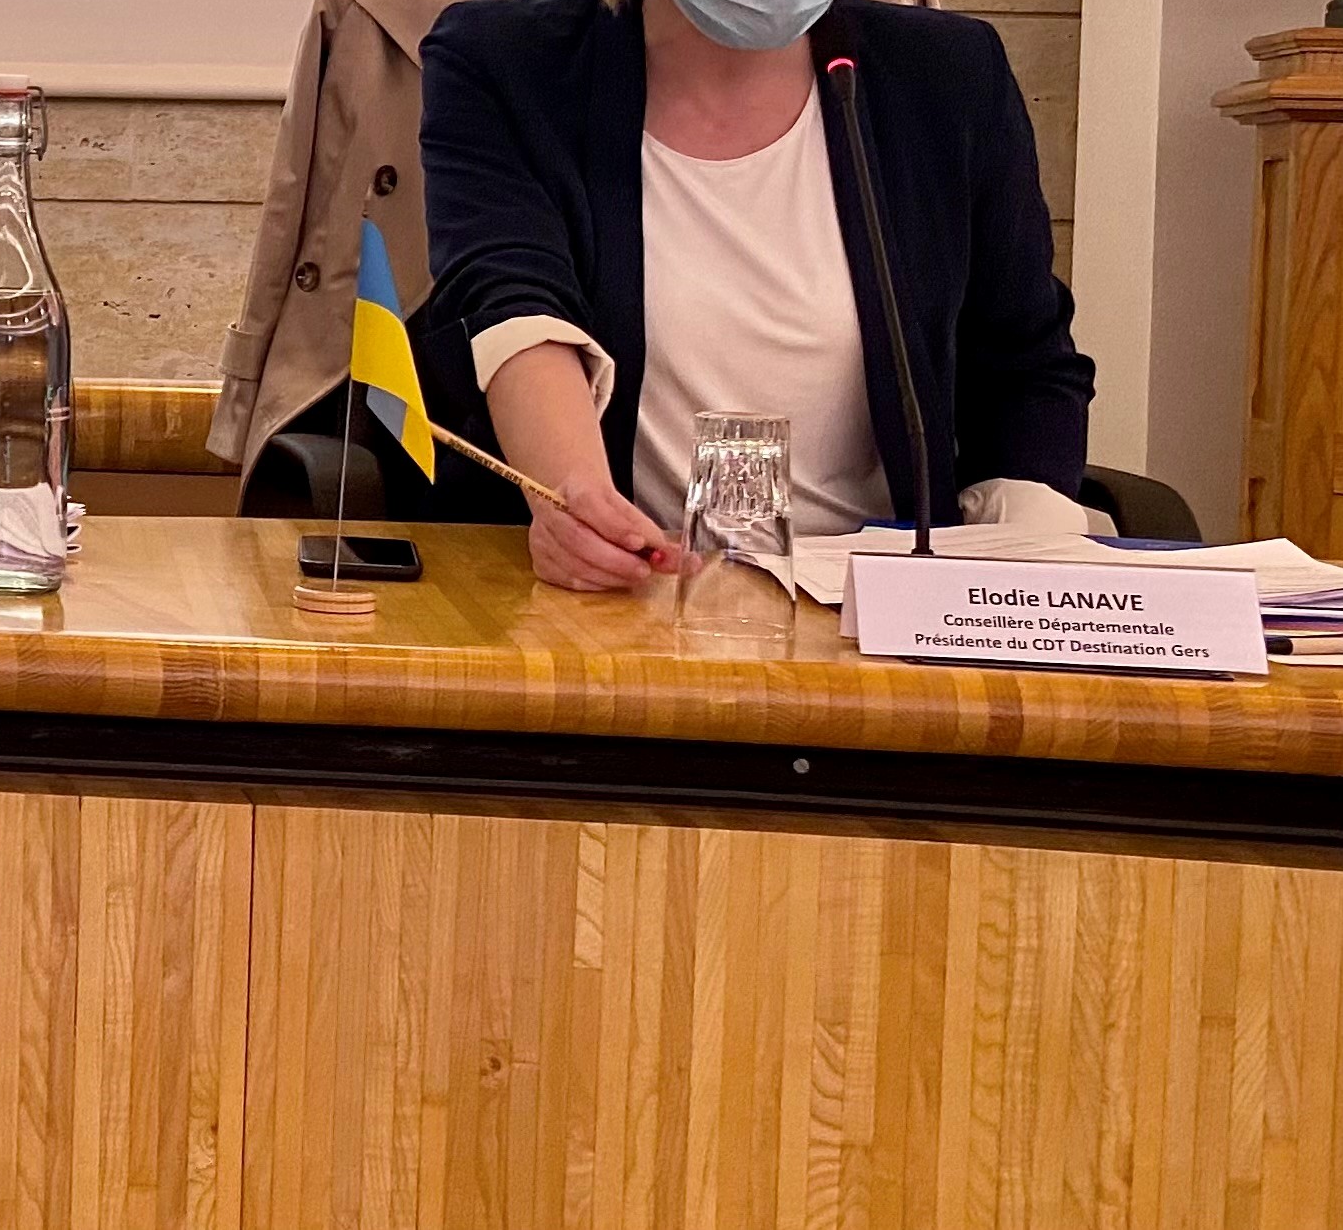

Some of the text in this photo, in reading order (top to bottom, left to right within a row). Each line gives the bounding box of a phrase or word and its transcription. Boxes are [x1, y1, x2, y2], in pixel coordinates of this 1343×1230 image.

[968, 588, 1146, 612] Elodie LANAVE
[943, 613, 1175, 636] Conseillère Départementale
[914, 632, 1211, 659] Présidente du CDT Destination Gers
